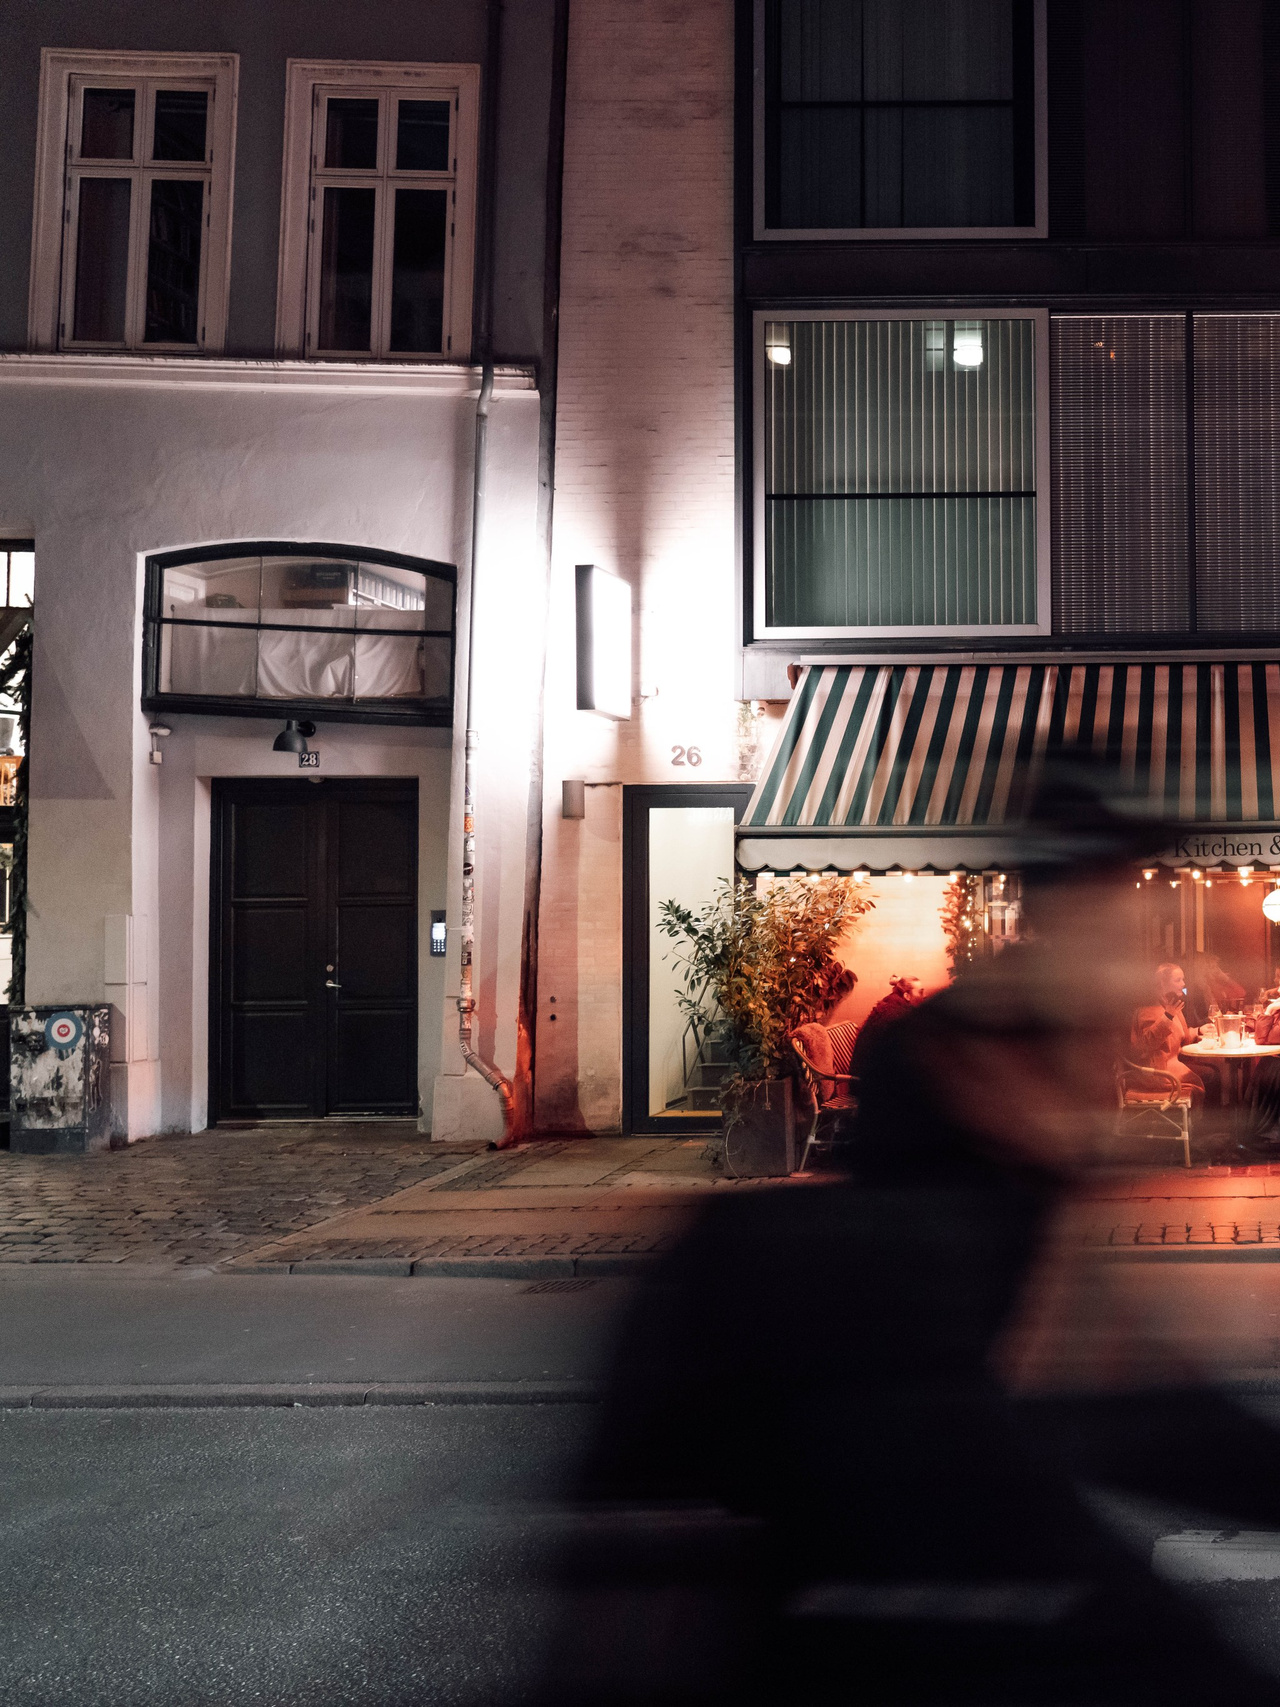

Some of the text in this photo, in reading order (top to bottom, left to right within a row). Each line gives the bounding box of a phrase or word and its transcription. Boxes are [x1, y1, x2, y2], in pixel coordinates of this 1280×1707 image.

[302, 753, 317, 765] 28
[671, 745, 702, 767] 26
[1173, 836, 1263, 858] Kitchen
